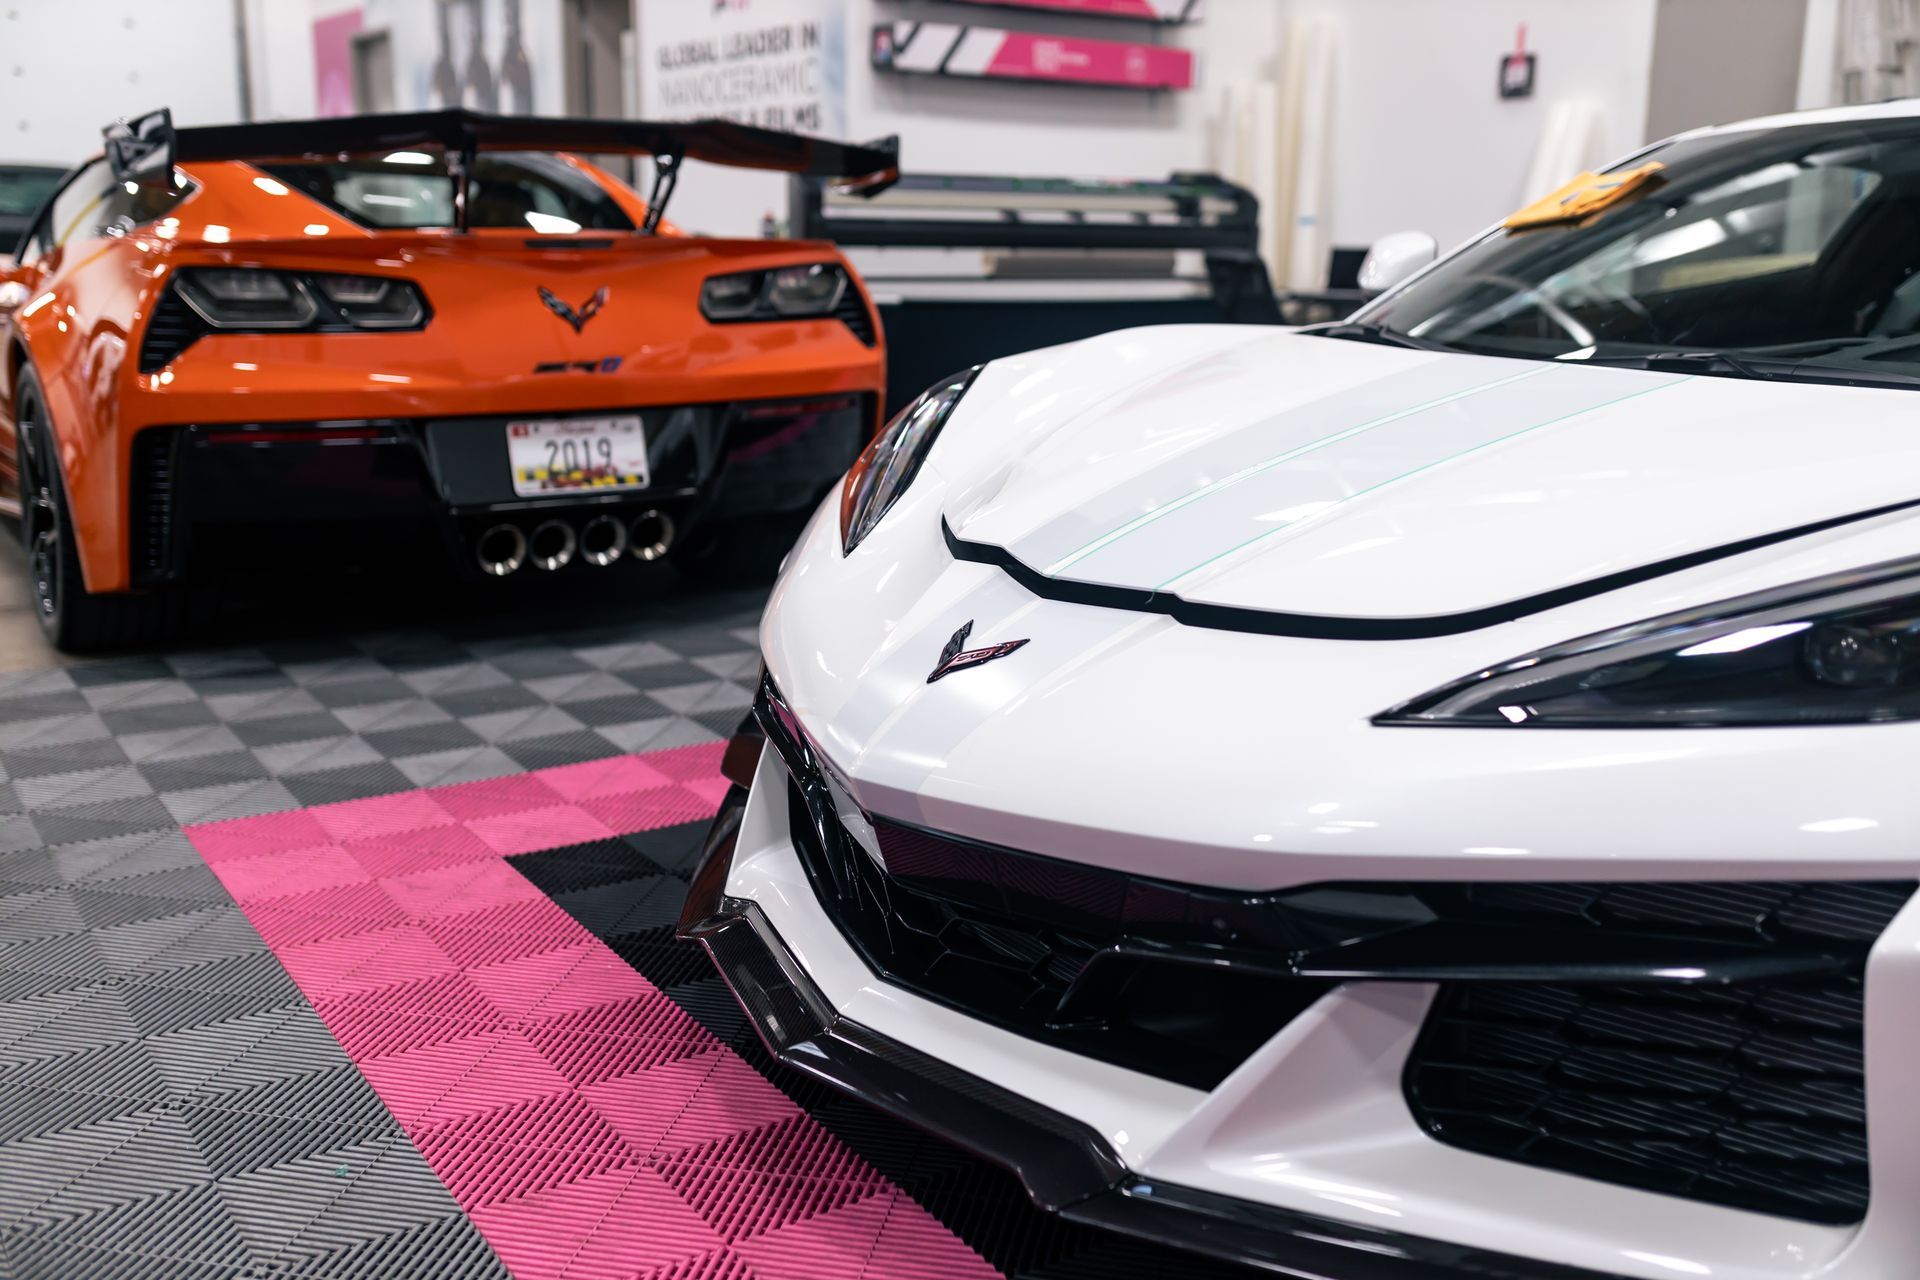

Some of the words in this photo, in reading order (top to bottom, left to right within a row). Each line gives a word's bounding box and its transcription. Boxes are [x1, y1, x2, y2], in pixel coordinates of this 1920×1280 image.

[657, 39, 718, 70] GLOBAL
[721, 26, 792, 60] LEADER
[544, 436, 612, 480] 2019
